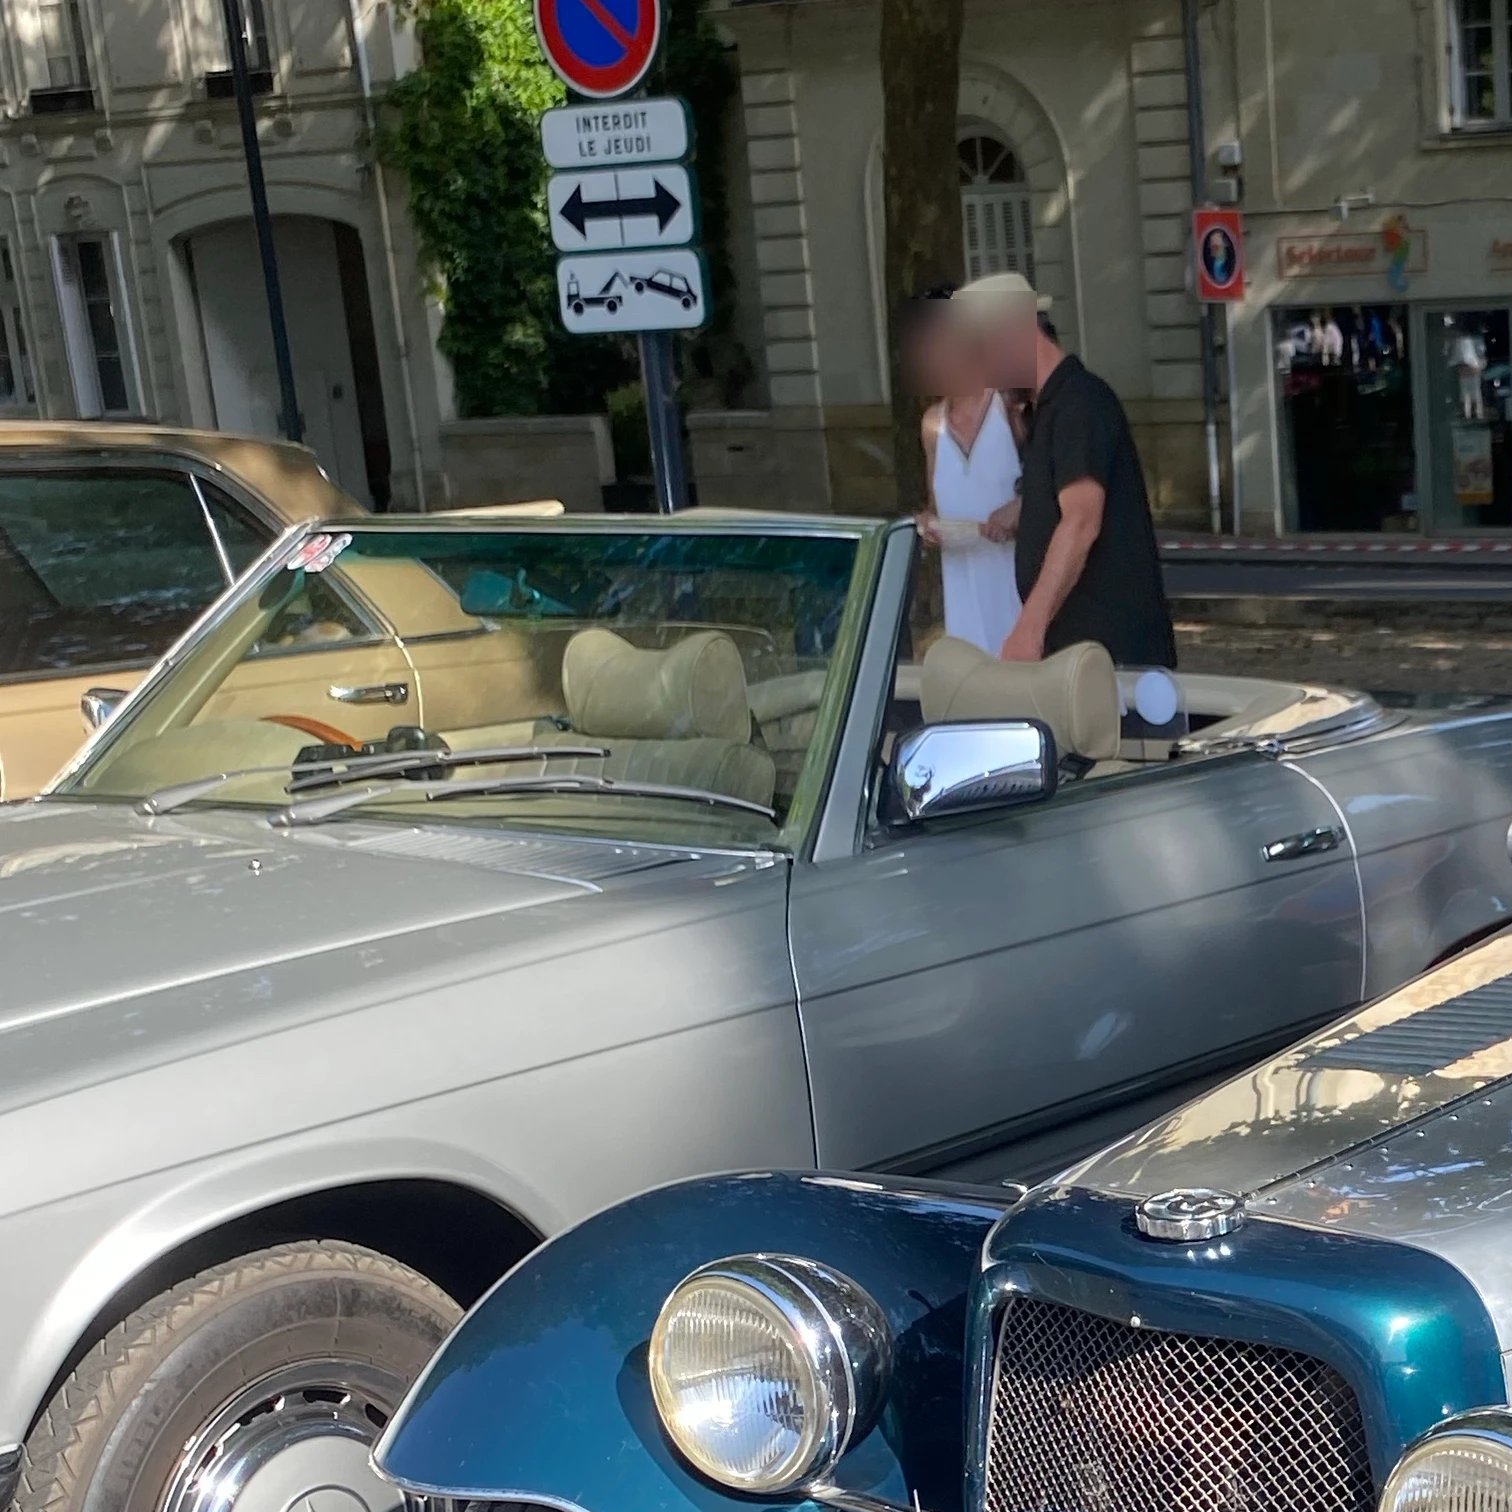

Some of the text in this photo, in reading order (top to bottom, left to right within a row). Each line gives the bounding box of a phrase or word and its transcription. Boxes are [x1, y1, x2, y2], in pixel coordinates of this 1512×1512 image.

[575, 111, 648, 133] INTERDIT
[578, 135, 652, 158] LE JEUDI
